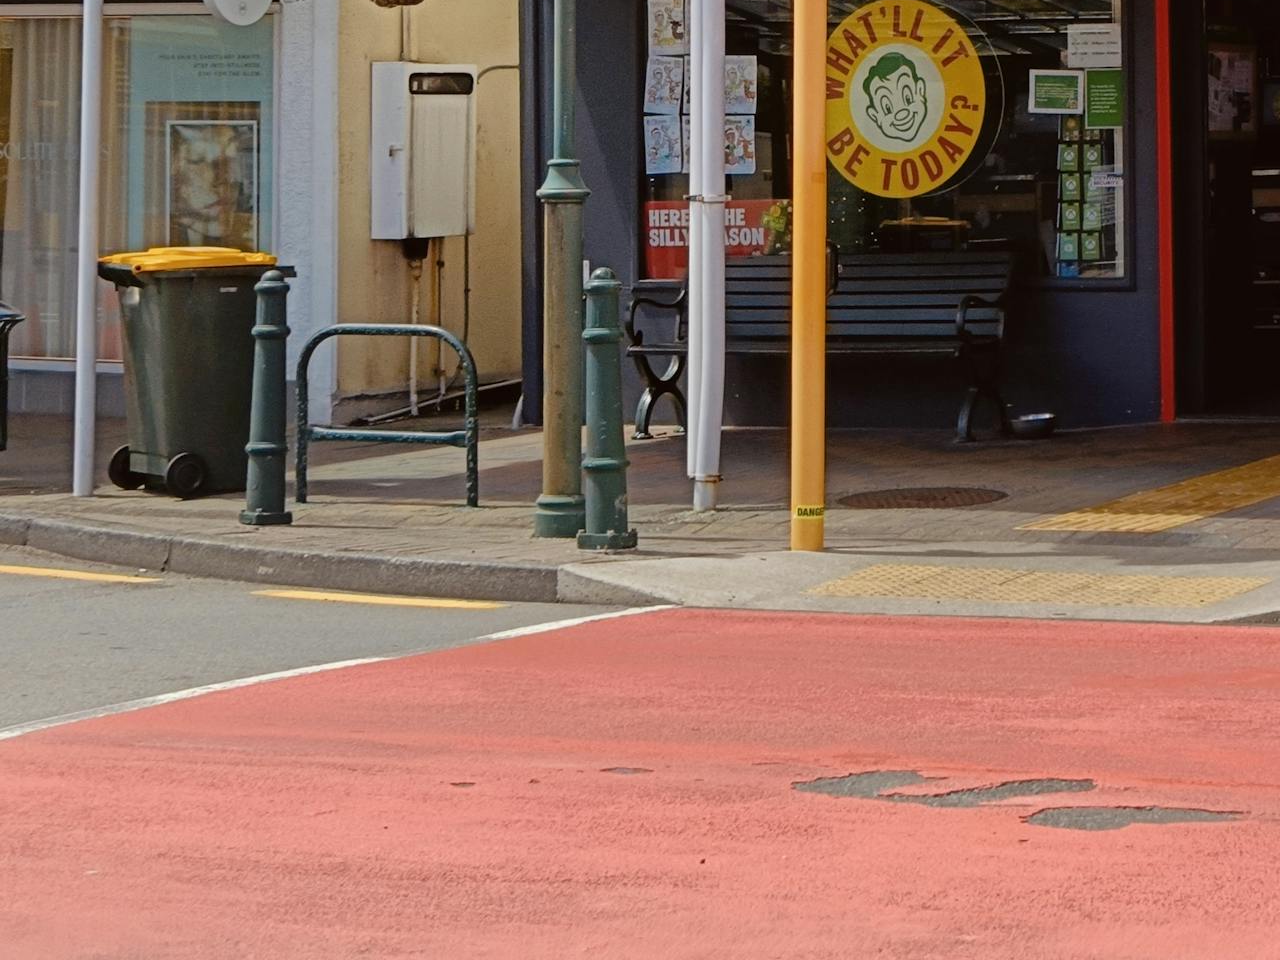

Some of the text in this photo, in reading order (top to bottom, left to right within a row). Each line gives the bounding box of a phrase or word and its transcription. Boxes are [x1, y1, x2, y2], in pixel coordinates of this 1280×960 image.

[826, 5, 969, 100] WHAT'LL IT
[826, 95, 979, 191] BE TODAY?
[725, 208, 746, 226] HE
